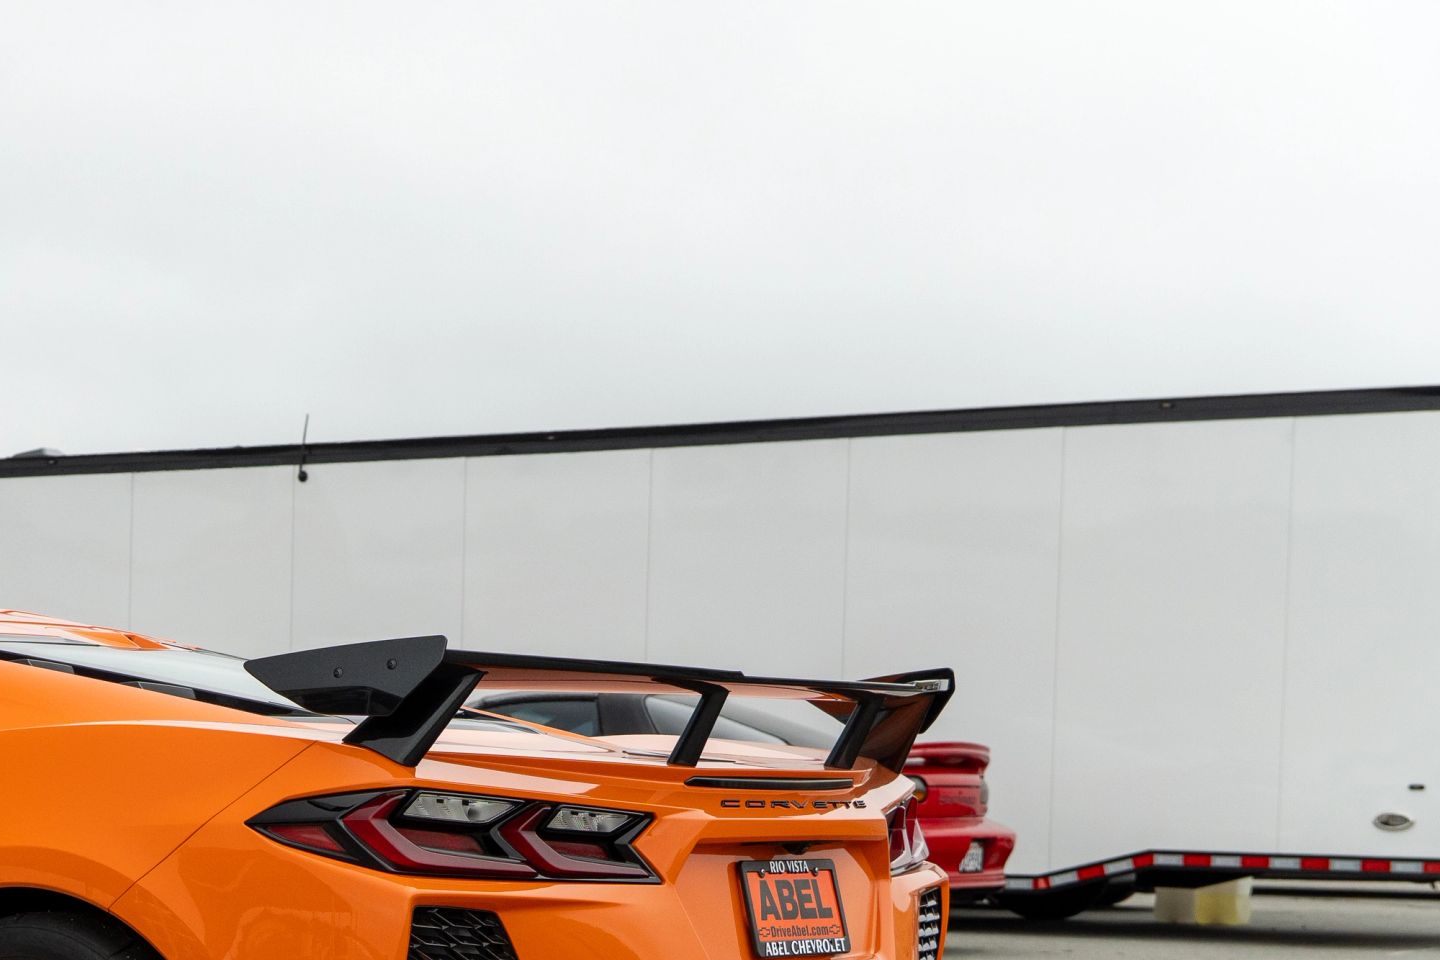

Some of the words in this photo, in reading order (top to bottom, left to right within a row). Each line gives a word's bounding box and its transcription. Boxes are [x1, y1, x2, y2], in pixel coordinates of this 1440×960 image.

[720, 799, 867, 810] CORVETTE
[769, 861, 786, 873] RIO
[786, 860, 810, 873] VISTA
[760, 879, 833, 920] ABEL
[771, 925, 830, 938] DriveAbel.com
[765, 940, 790, 957] ABEL
[791, 937, 846, 955] CHEVROLET
